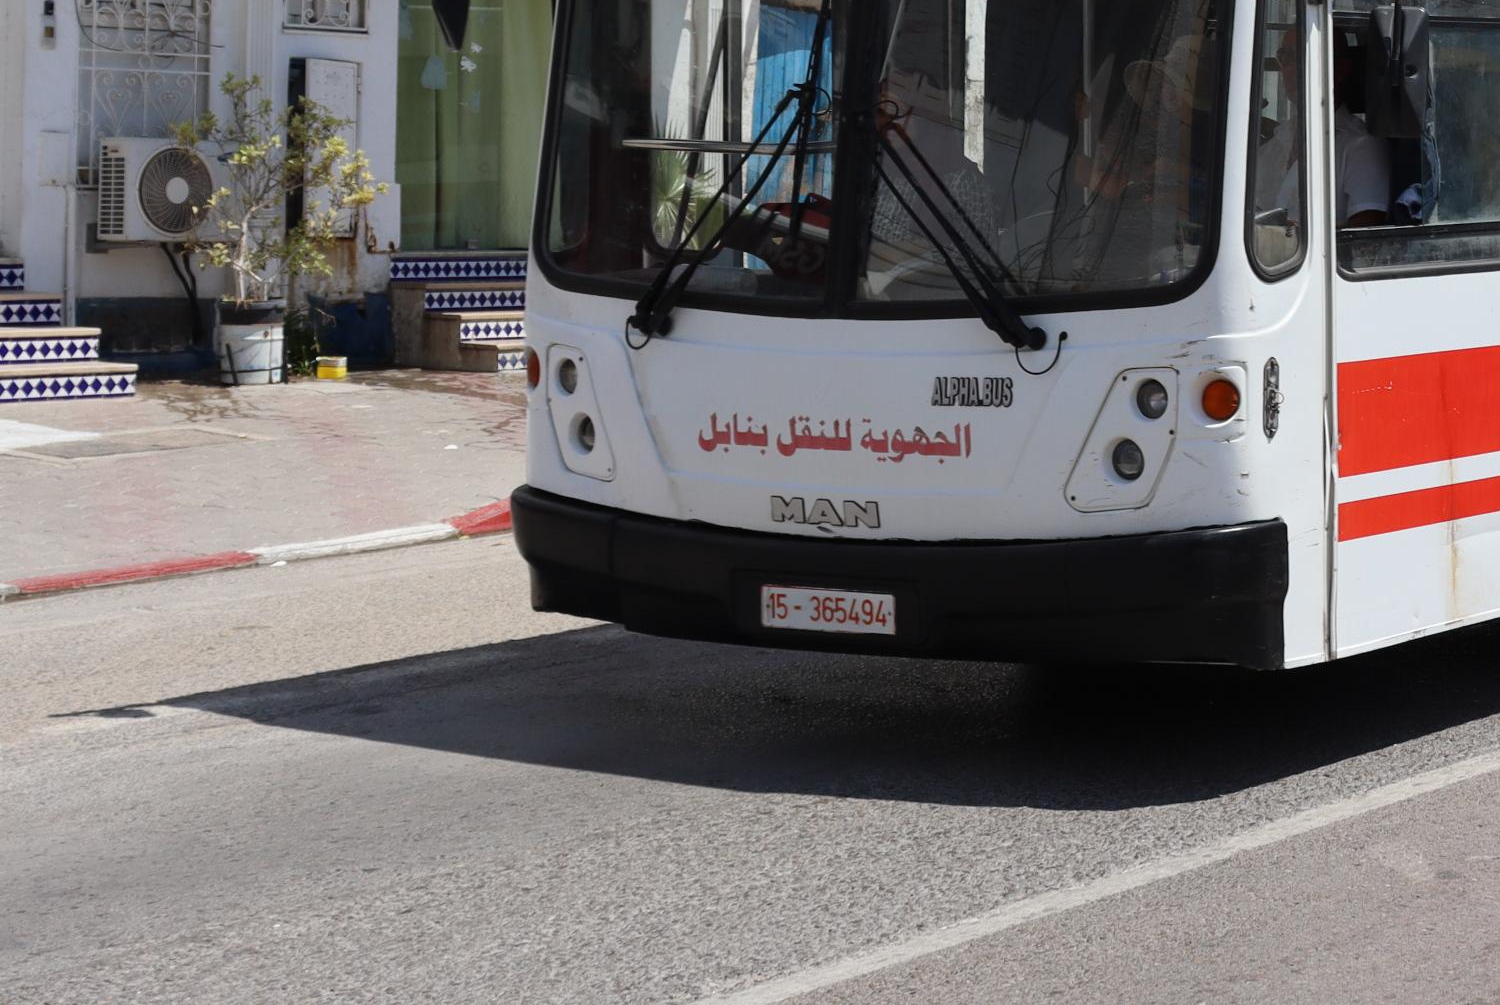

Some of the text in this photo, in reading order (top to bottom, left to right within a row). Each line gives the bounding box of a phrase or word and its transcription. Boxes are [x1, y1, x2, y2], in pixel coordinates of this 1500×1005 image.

[698, 412, 972, 463] الجهوية للنقل بنابل
[770, 495, 881, 528] MAN
